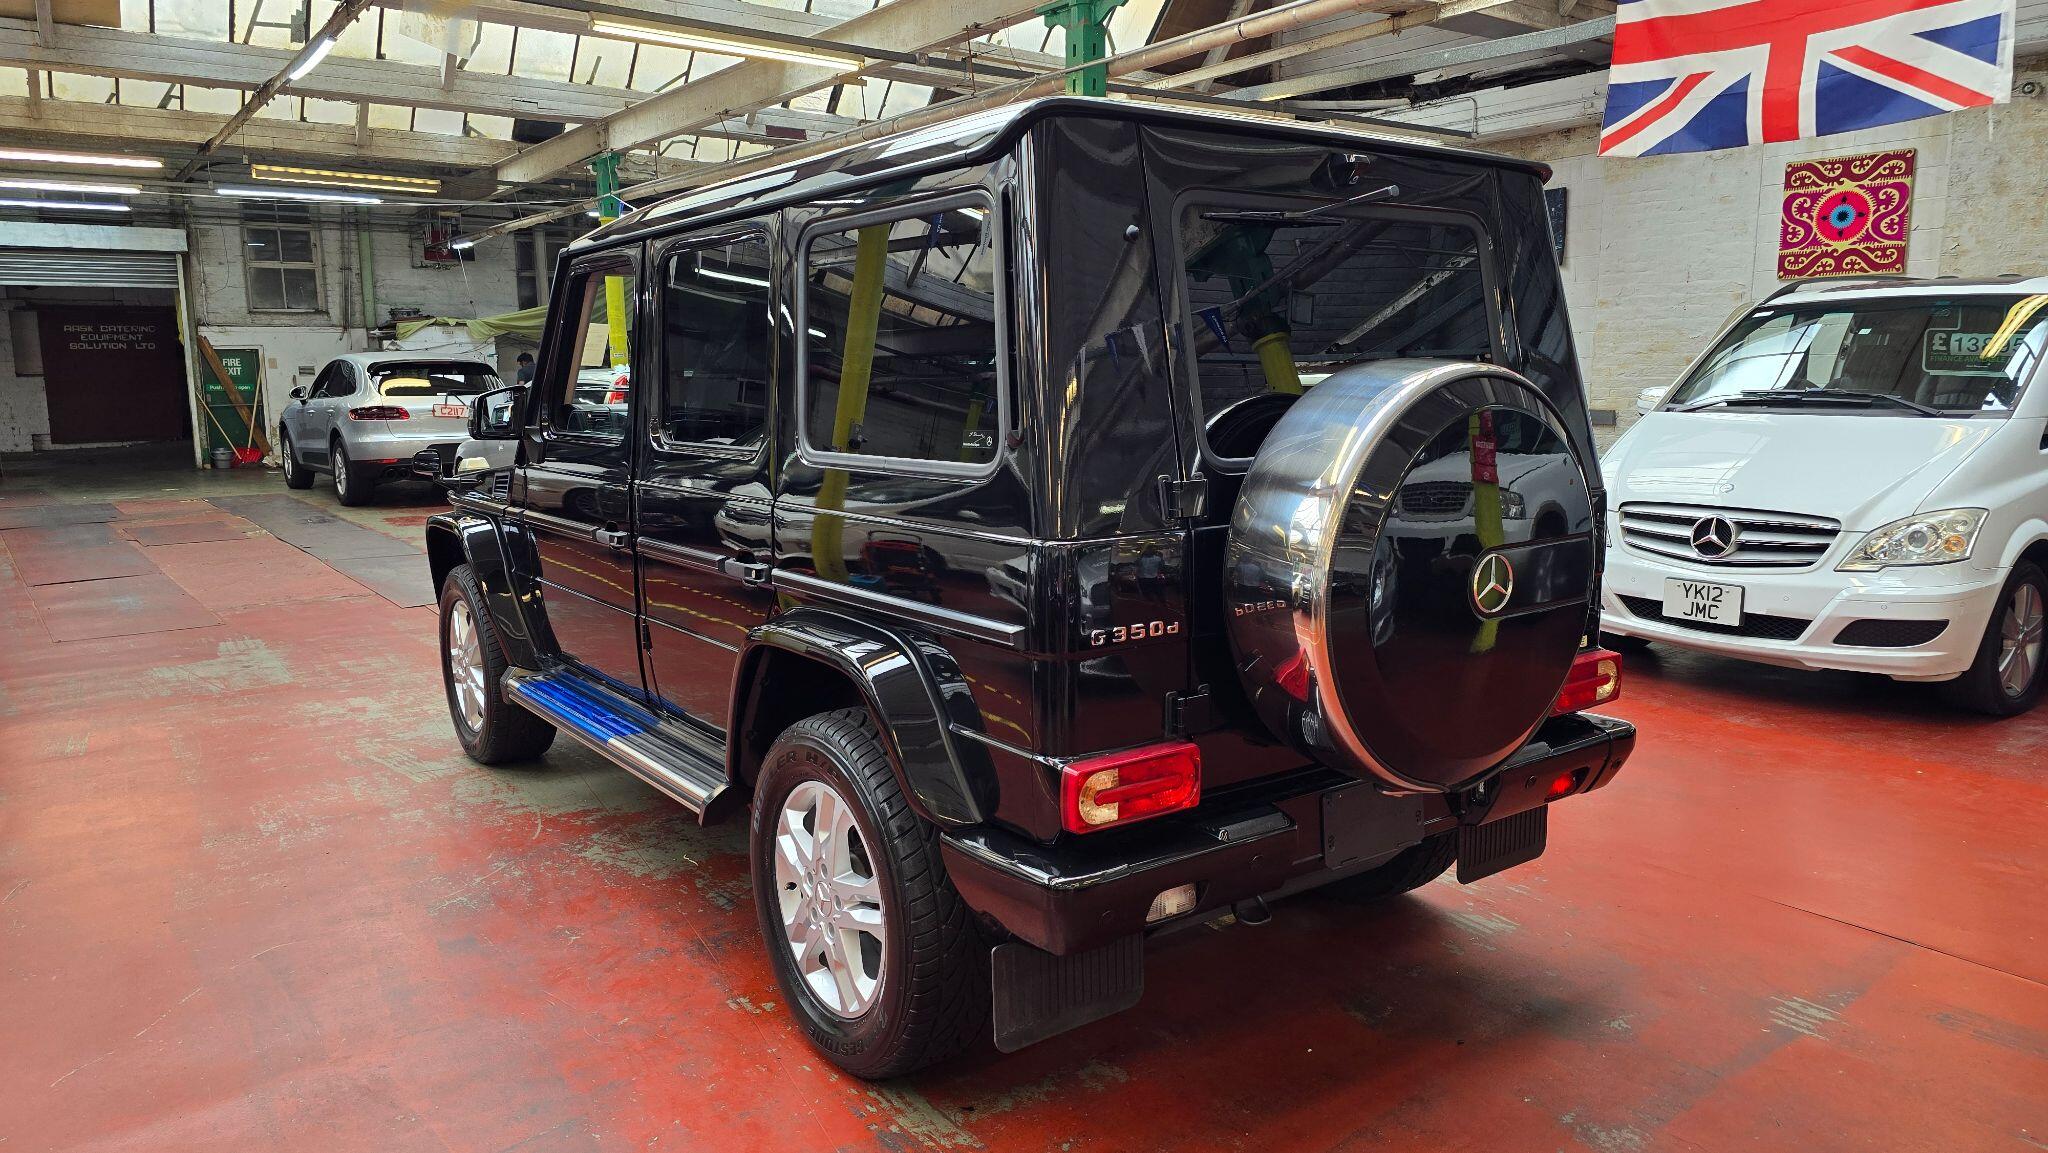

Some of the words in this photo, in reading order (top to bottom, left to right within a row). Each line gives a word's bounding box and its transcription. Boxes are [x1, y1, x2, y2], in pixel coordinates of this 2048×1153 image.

[80, 333, 143, 341] EQUIPMENT
[69, 342, 127, 350] SOLUTION
[135, 342, 156, 350] LTD
[222, 358, 242, 367] FIRE
[1682, 582, 1724, 603] YK12
[1682, 601, 1720, 620] JMC
